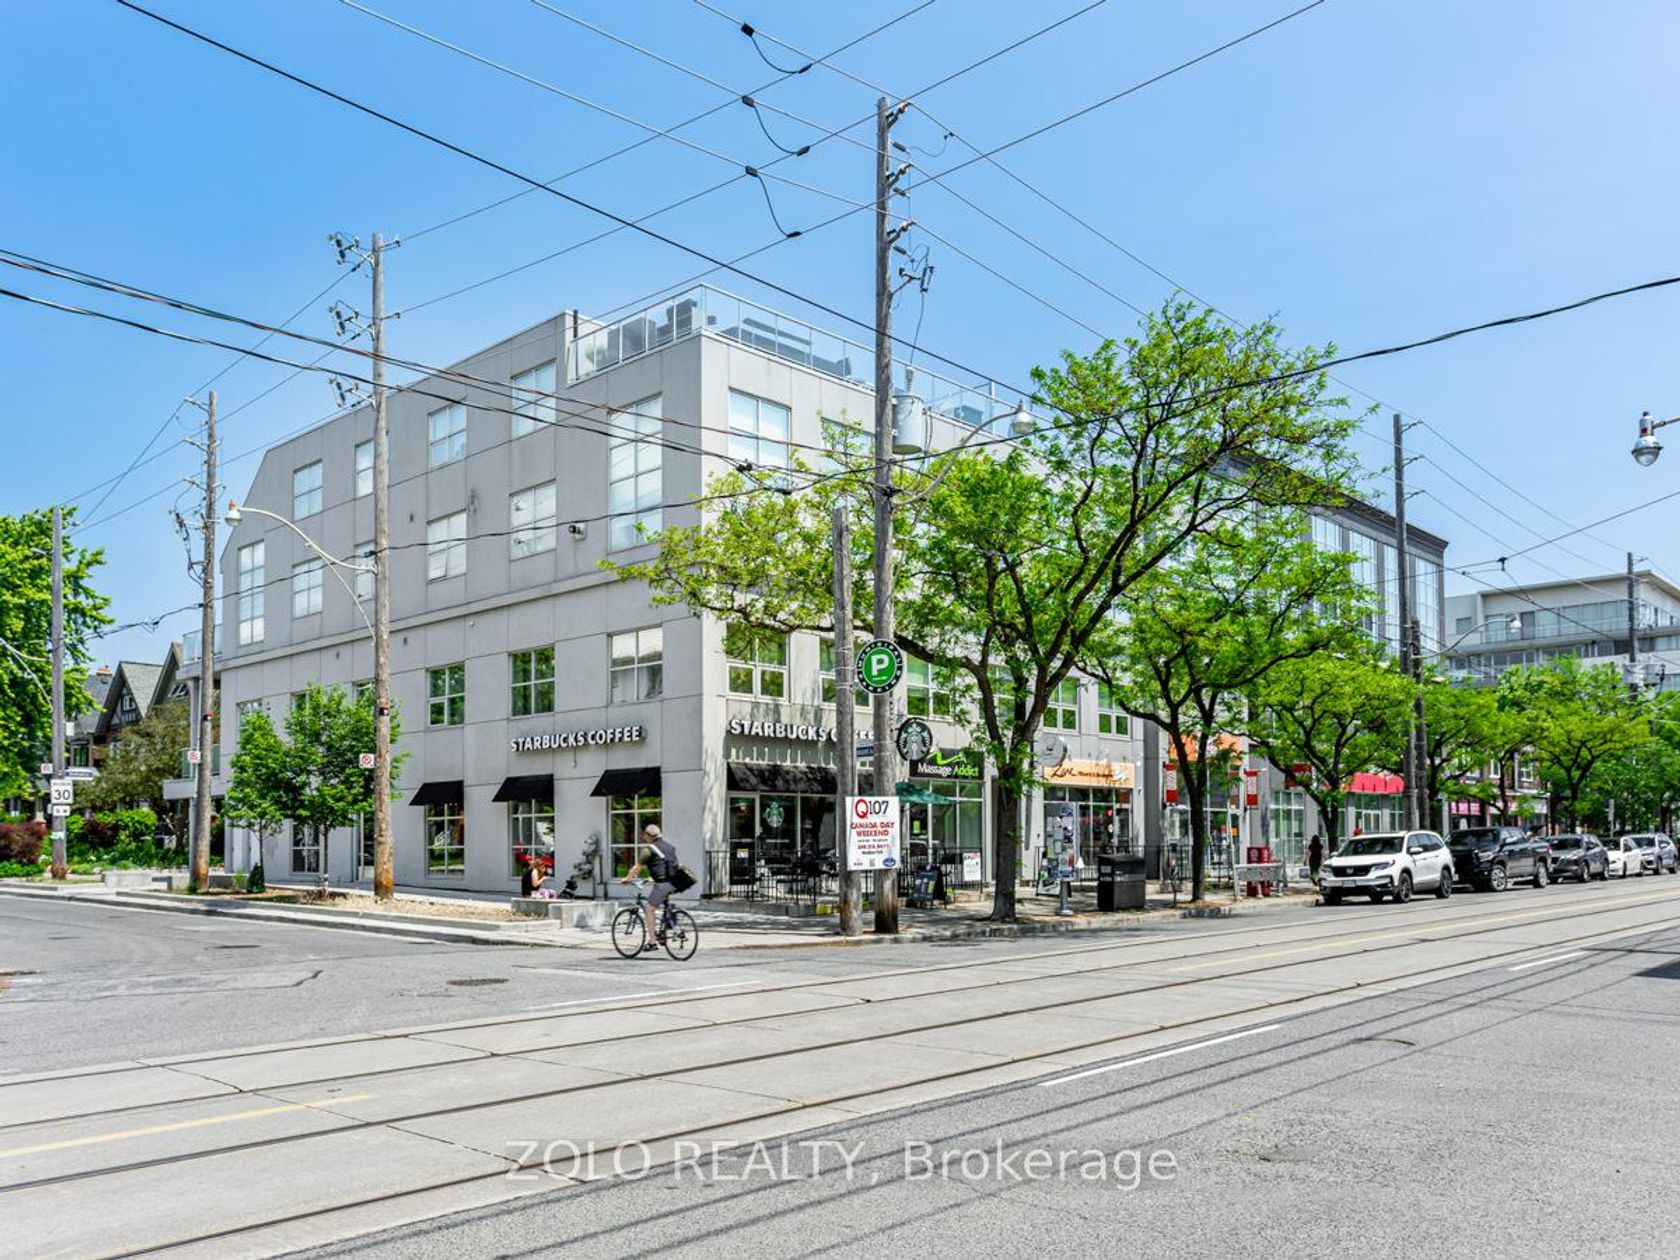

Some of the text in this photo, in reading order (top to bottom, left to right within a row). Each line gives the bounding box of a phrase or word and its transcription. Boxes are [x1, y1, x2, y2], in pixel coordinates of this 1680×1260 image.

[871, 654, 889, 676] P
[511, 726, 640, 752] STARBUCKS COFFEE
[730, 719, 828, 742] STARBUCKS
[917, 762, 979, 777] Massage Addict
[54, 789, 71, 800] 30
[855, 798, 889, 819] Q107
[850, 821, 895, 830] CANADA DAY
[856, 829, 889, 837] WEEKEND
